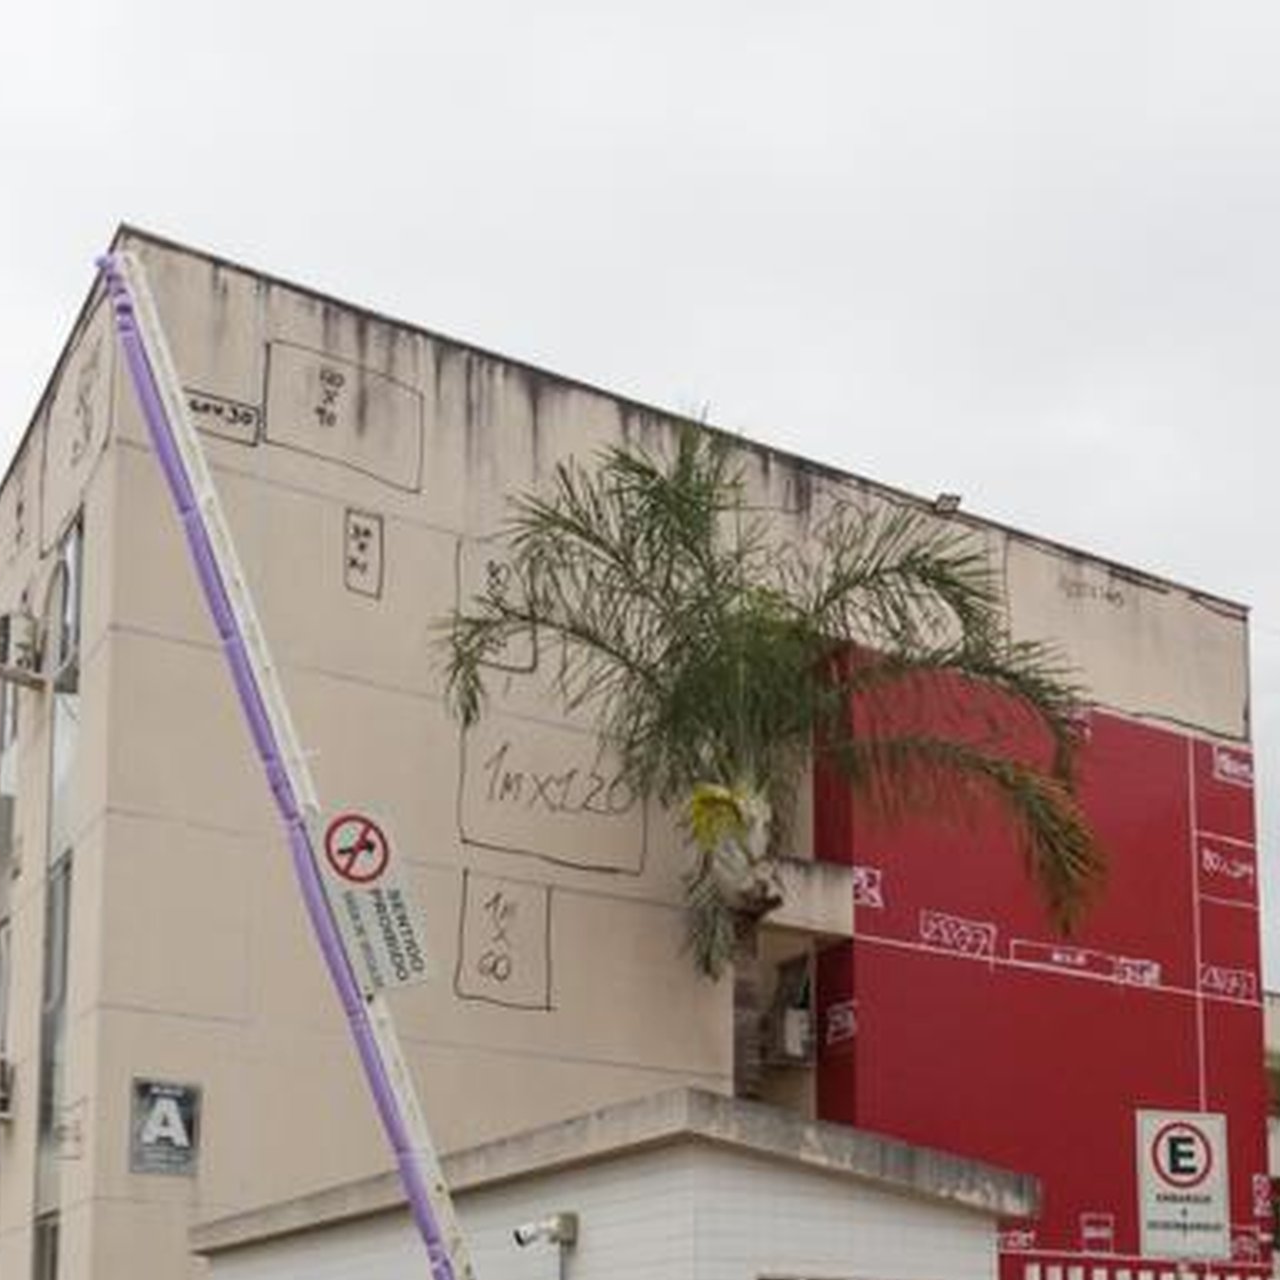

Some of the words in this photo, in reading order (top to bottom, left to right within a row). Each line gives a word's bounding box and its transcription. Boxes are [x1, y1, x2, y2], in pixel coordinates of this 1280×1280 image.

[369, 888, 408, 981] PROIBIDO
[387, 889, 425, 973] SENTIDO
[142, 1096, 190, 1147] A
[1168, 1135, 1197, 1175] E
